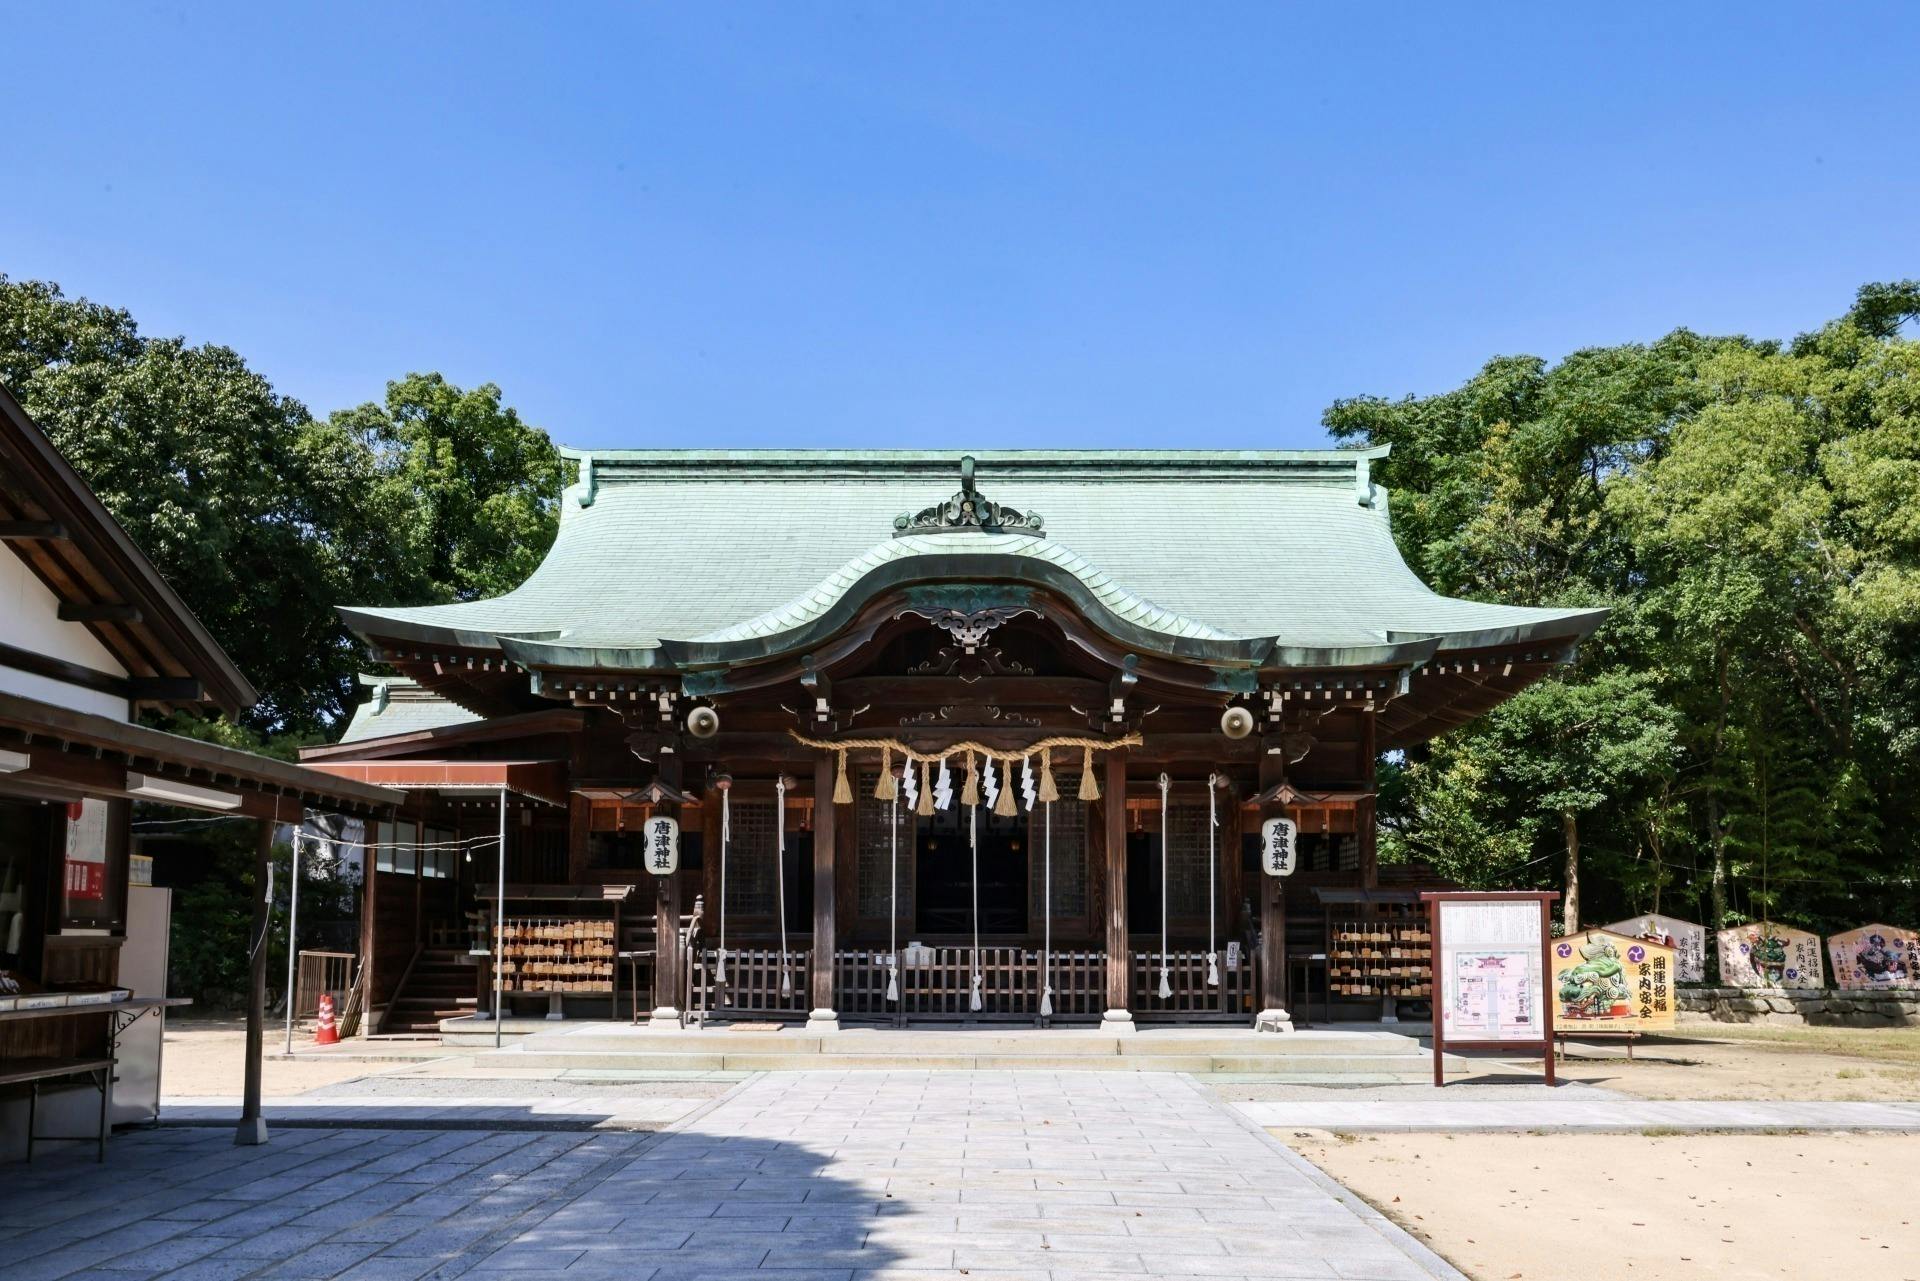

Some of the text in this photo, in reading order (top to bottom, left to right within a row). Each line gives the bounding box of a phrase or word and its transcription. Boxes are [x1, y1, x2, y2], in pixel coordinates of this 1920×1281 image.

[654, 820, 671, 869] 唐津神社
[1272, 822, 1290, 870] 唐津神社
[1678, 937, 1689, 980] 家内安全
[1690, 930, 1701, 973] 開運招福
[1795, 943, 1808, 984] 家内安全
[1806, 937, 1820, 978] 開運招福
[1638, 962, 1653, 1019] 家内安全
[1653, 956, 1667, 1012] 開運招福
